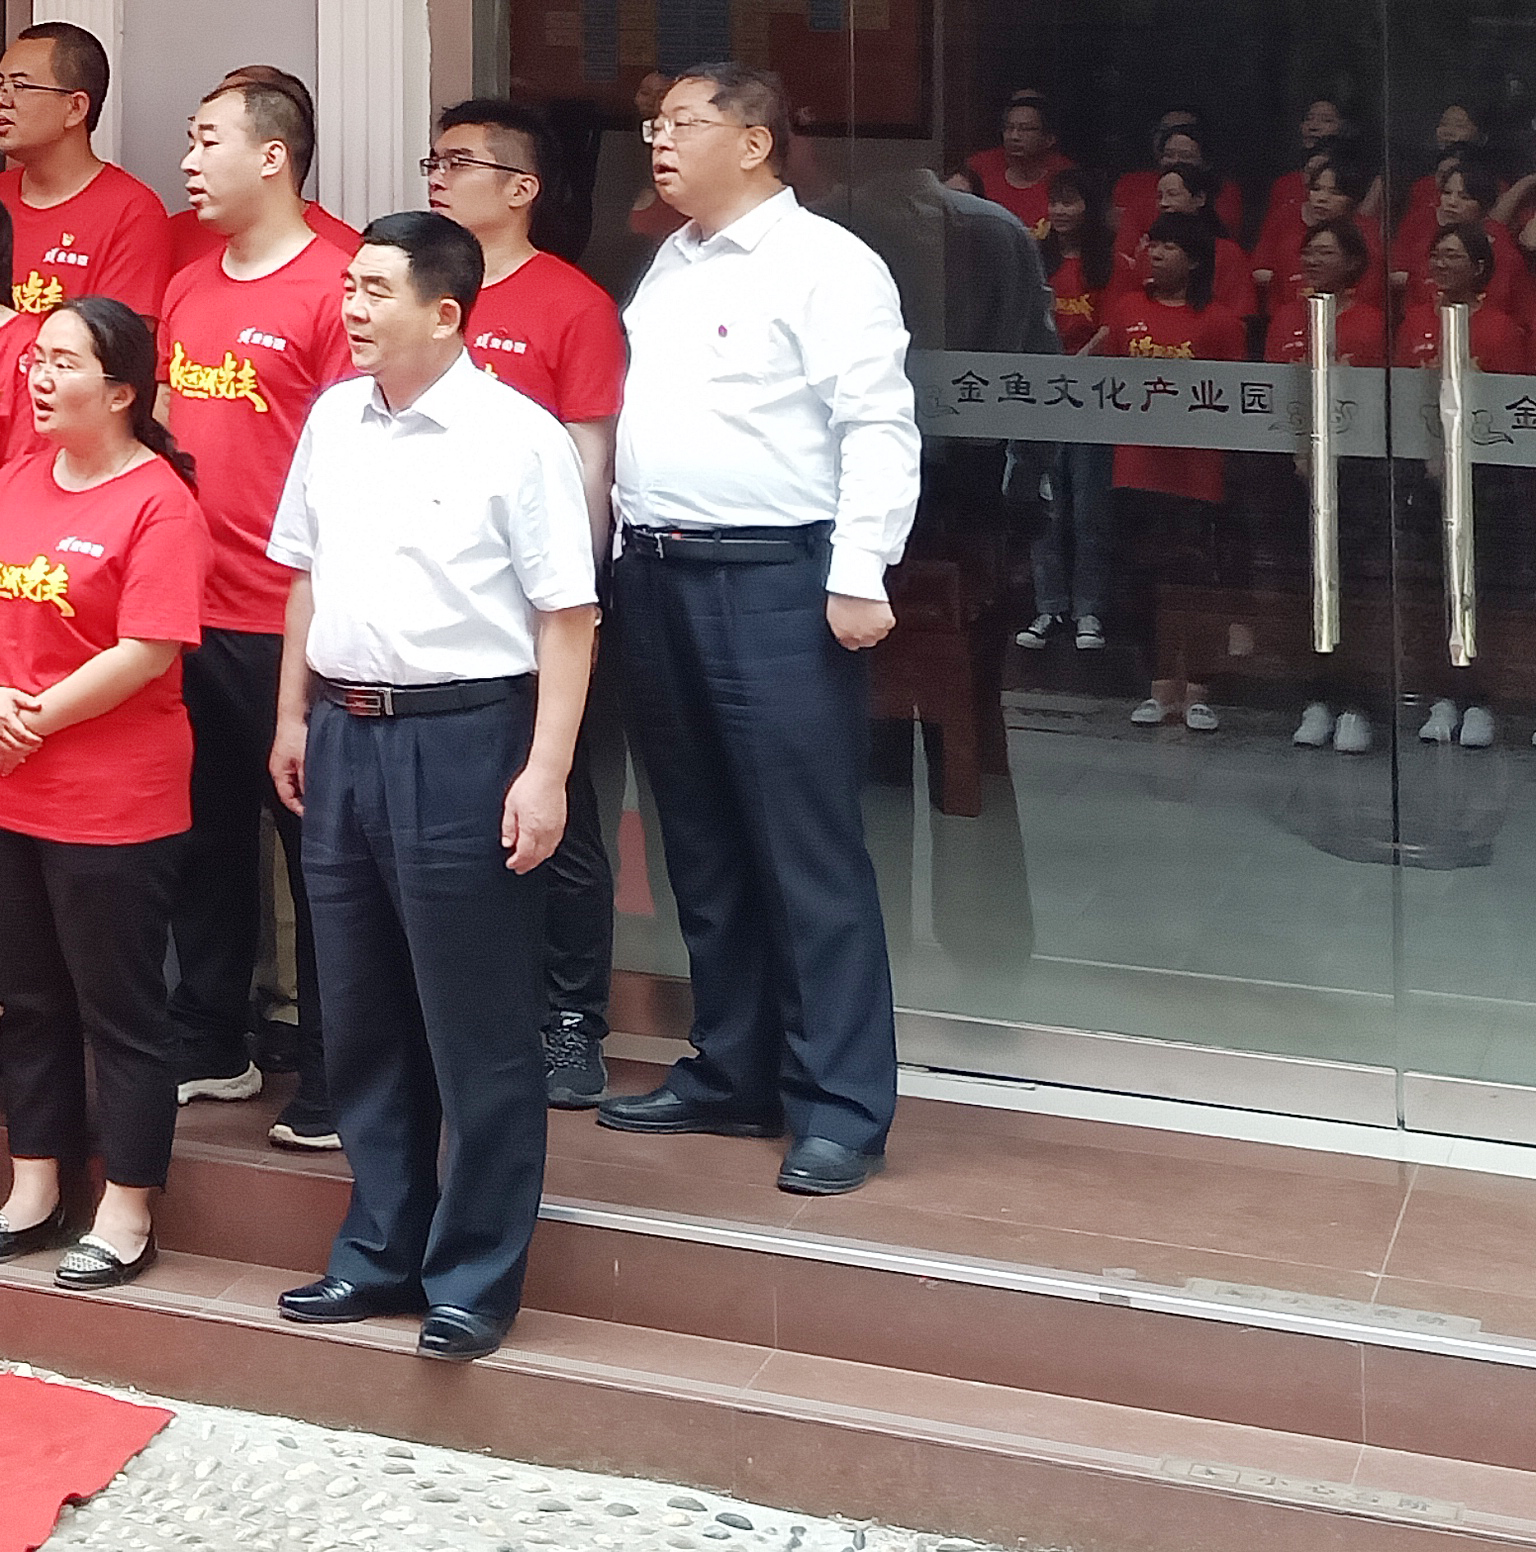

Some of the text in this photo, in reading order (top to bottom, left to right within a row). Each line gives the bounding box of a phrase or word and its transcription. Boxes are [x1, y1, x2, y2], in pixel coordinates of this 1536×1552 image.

[951, 369, 1275, 415] 金鱼文化产业园
